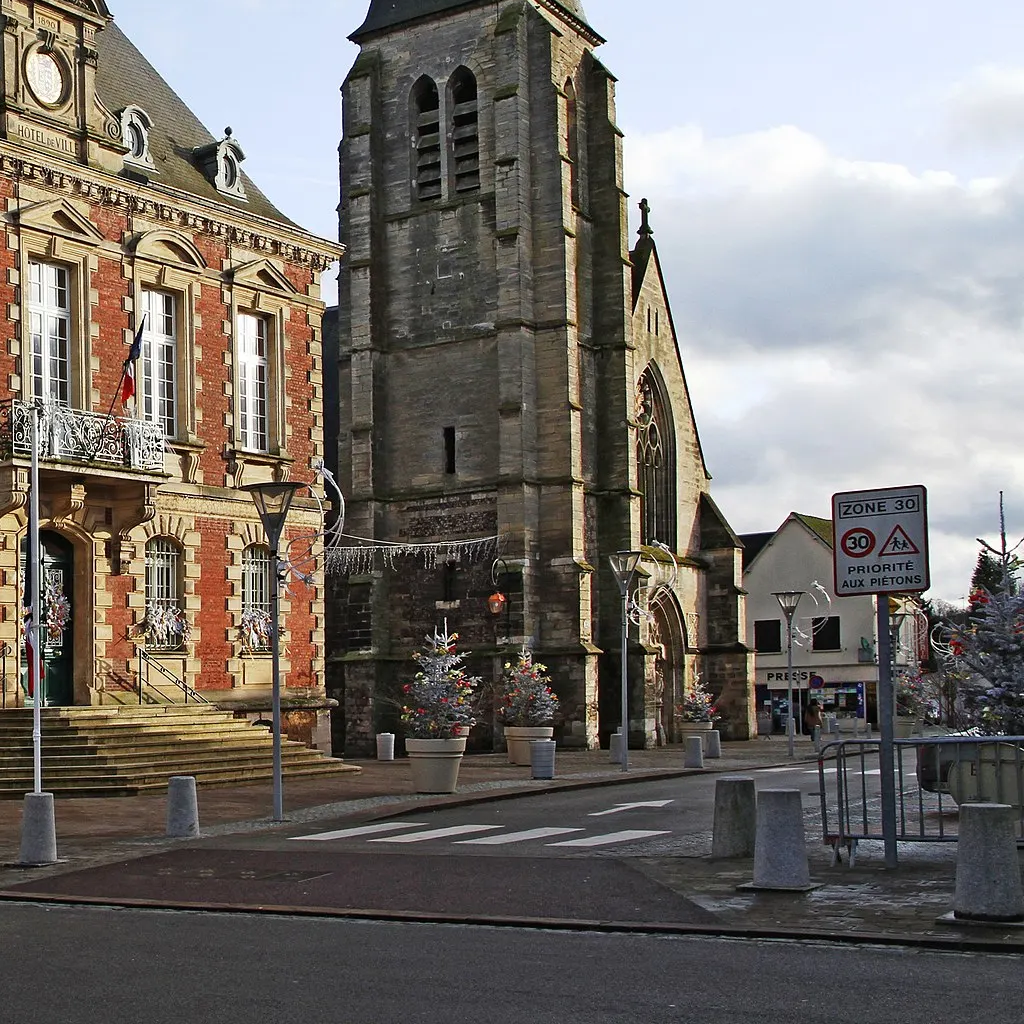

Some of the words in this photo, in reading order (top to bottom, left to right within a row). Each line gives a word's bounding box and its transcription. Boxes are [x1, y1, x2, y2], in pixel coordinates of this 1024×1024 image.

[842, 501, 887, 515] ZONE
[894, 498, 916, 511] 30
[847, 535, 870, 550] 30
[847, 560, 914, 575] PRIORITÉ
[842, 578, 865, 589] AUX
[870, 574, 922, 587] PIÉTONS
